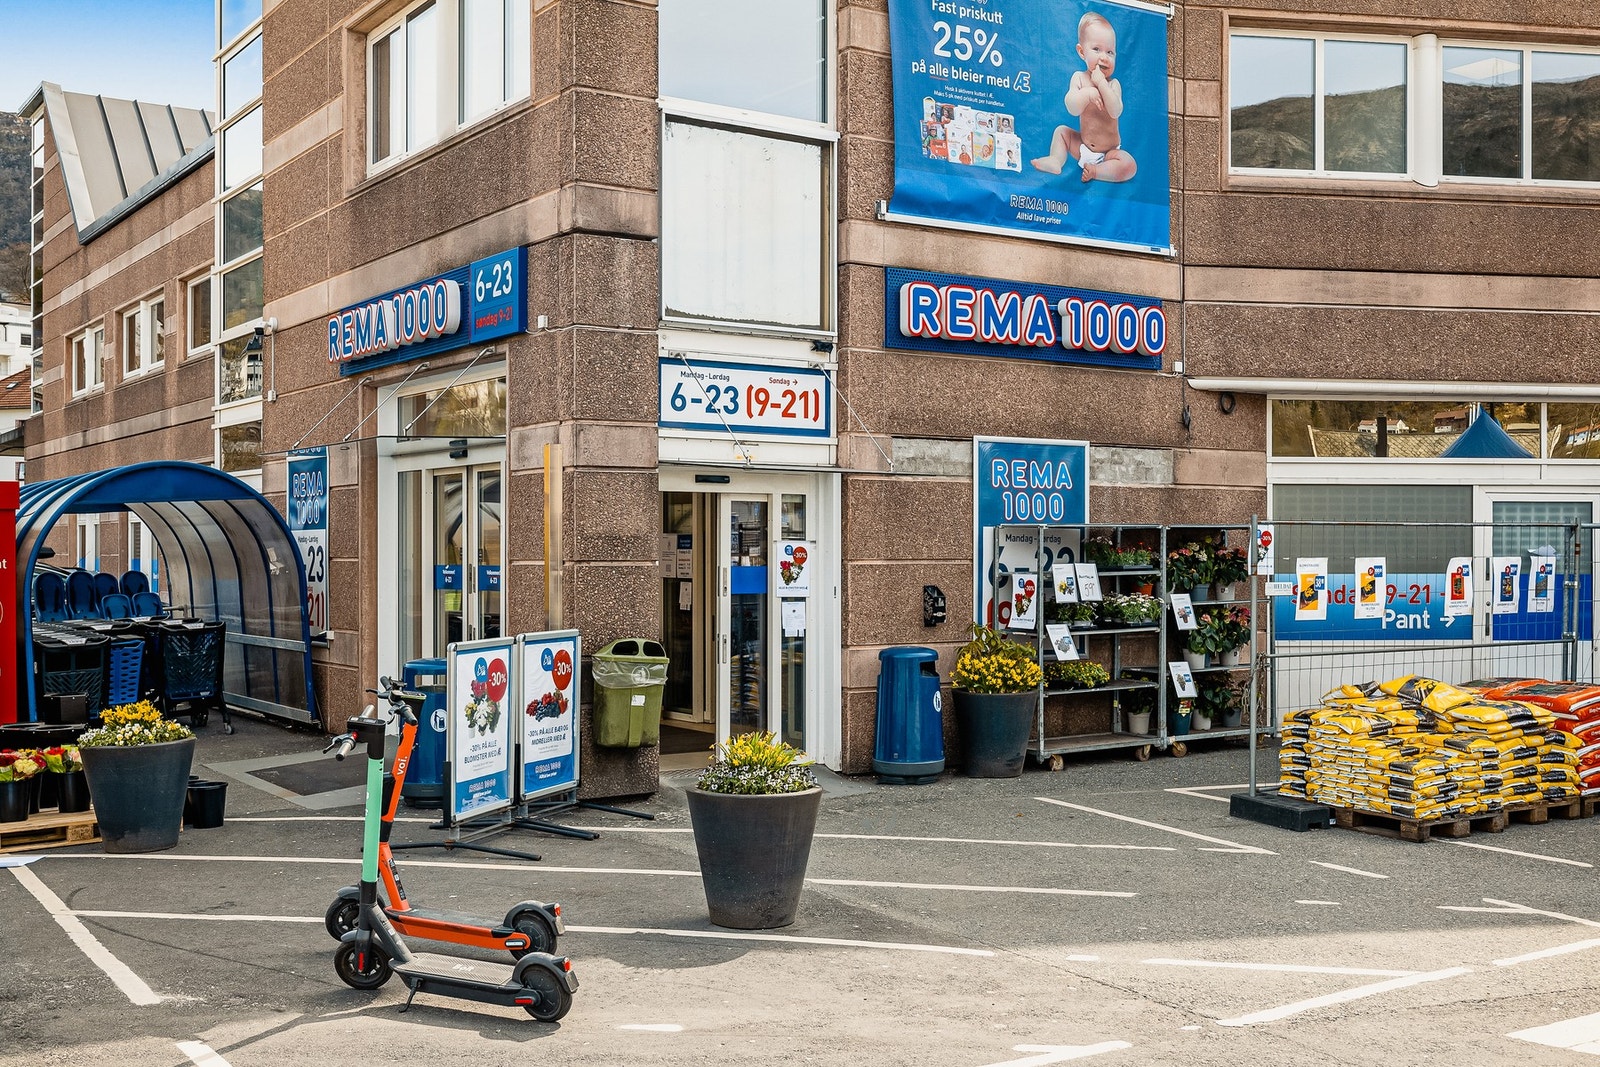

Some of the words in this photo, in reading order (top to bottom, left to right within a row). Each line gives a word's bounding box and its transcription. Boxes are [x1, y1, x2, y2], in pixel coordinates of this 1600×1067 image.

[932, 0, 956, 14] Fast
[960, 8, 1003, 24] priskutt
[933, 21, 1003, 67] 25%
[912, 59, 926, 74] på
[929, 63, 949, 78] alle
[951, 66, 984, 84] bleier
[986, 76, 1010, 88] med
[1013, 71, 1031, 93] Æ
[1010, 194, 1043, 211] REMA
[1045, 199, 1069, 215] 1000
[1016, 211, 1033, 221] Alltid
[1045, 216, 1062, 225] priser
[475, 260, 512, 302] 6-23
[328, 300, 388, 363] REMA
[392, 279, 449, 345] 1000
[904, 281, 1056, 347] REMA
[1062, 297, 1167, 356] 1000
[670, 382, 739, 415] 6-23
[746, 384, 819, 423] (9-21)
[293, 471, 323, 498] REMA
[991, 459, 1073, 490] REMA
[297, 498, 320, 525] 1000
[1002, 491, 1065, 521] 1000
[1386, 584, 1431, 604] 9-21
[1382, 609, 1431, 630] Pant
[488, 671, 507, 687] -30%
[554, 661, 572, 676] -30%
[397, 756, 408, 775] voi.
[464, 751, 488, 764] BLOMSTER
